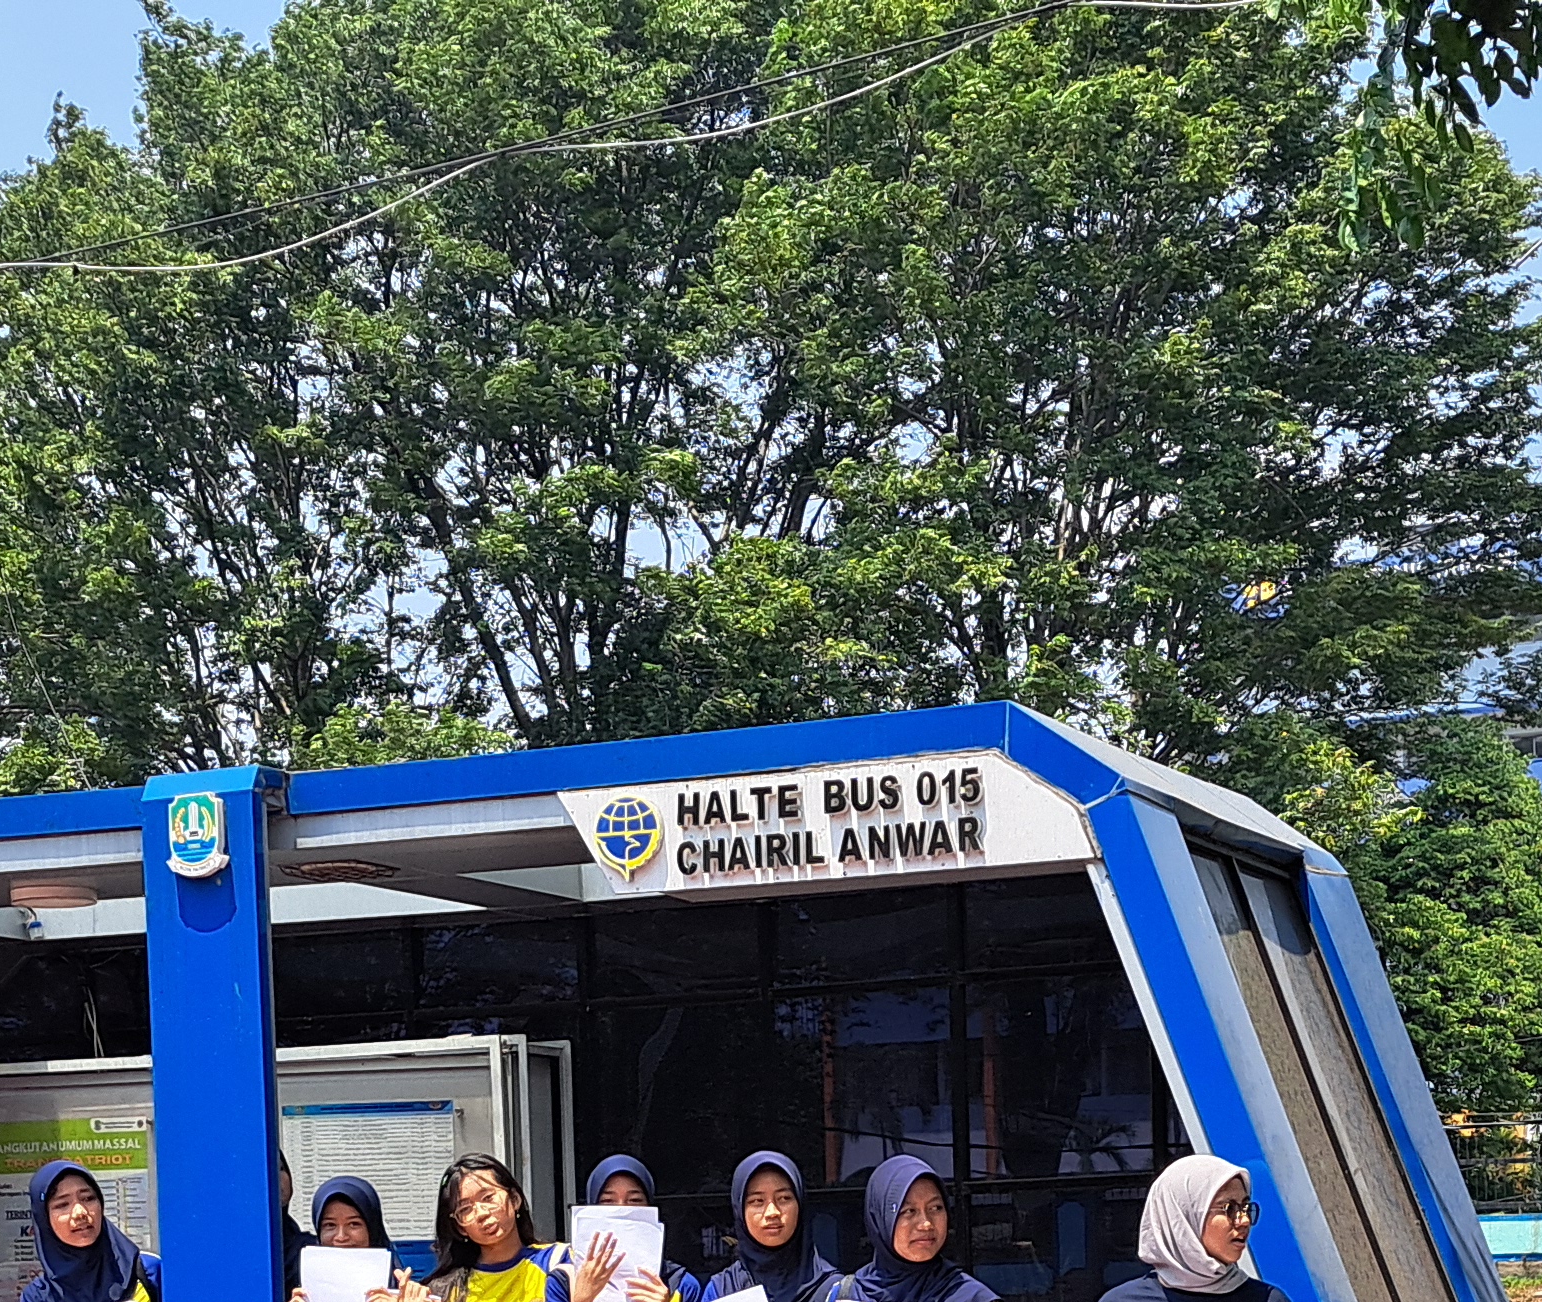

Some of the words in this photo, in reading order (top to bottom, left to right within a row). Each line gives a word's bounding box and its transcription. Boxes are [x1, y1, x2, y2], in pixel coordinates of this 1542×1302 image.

[676, 783, 800, 828] HALTE
[823, 774, 901, 815] BUS
[916, 766, 983, 806] 015
[676, 829, 826, 875] CHAIRIL
[838, 816, 983, 863] ANWAR
[59, 1139, 93, 1151] UMUM
[94, 1137, 141, 1150] MASSAL
